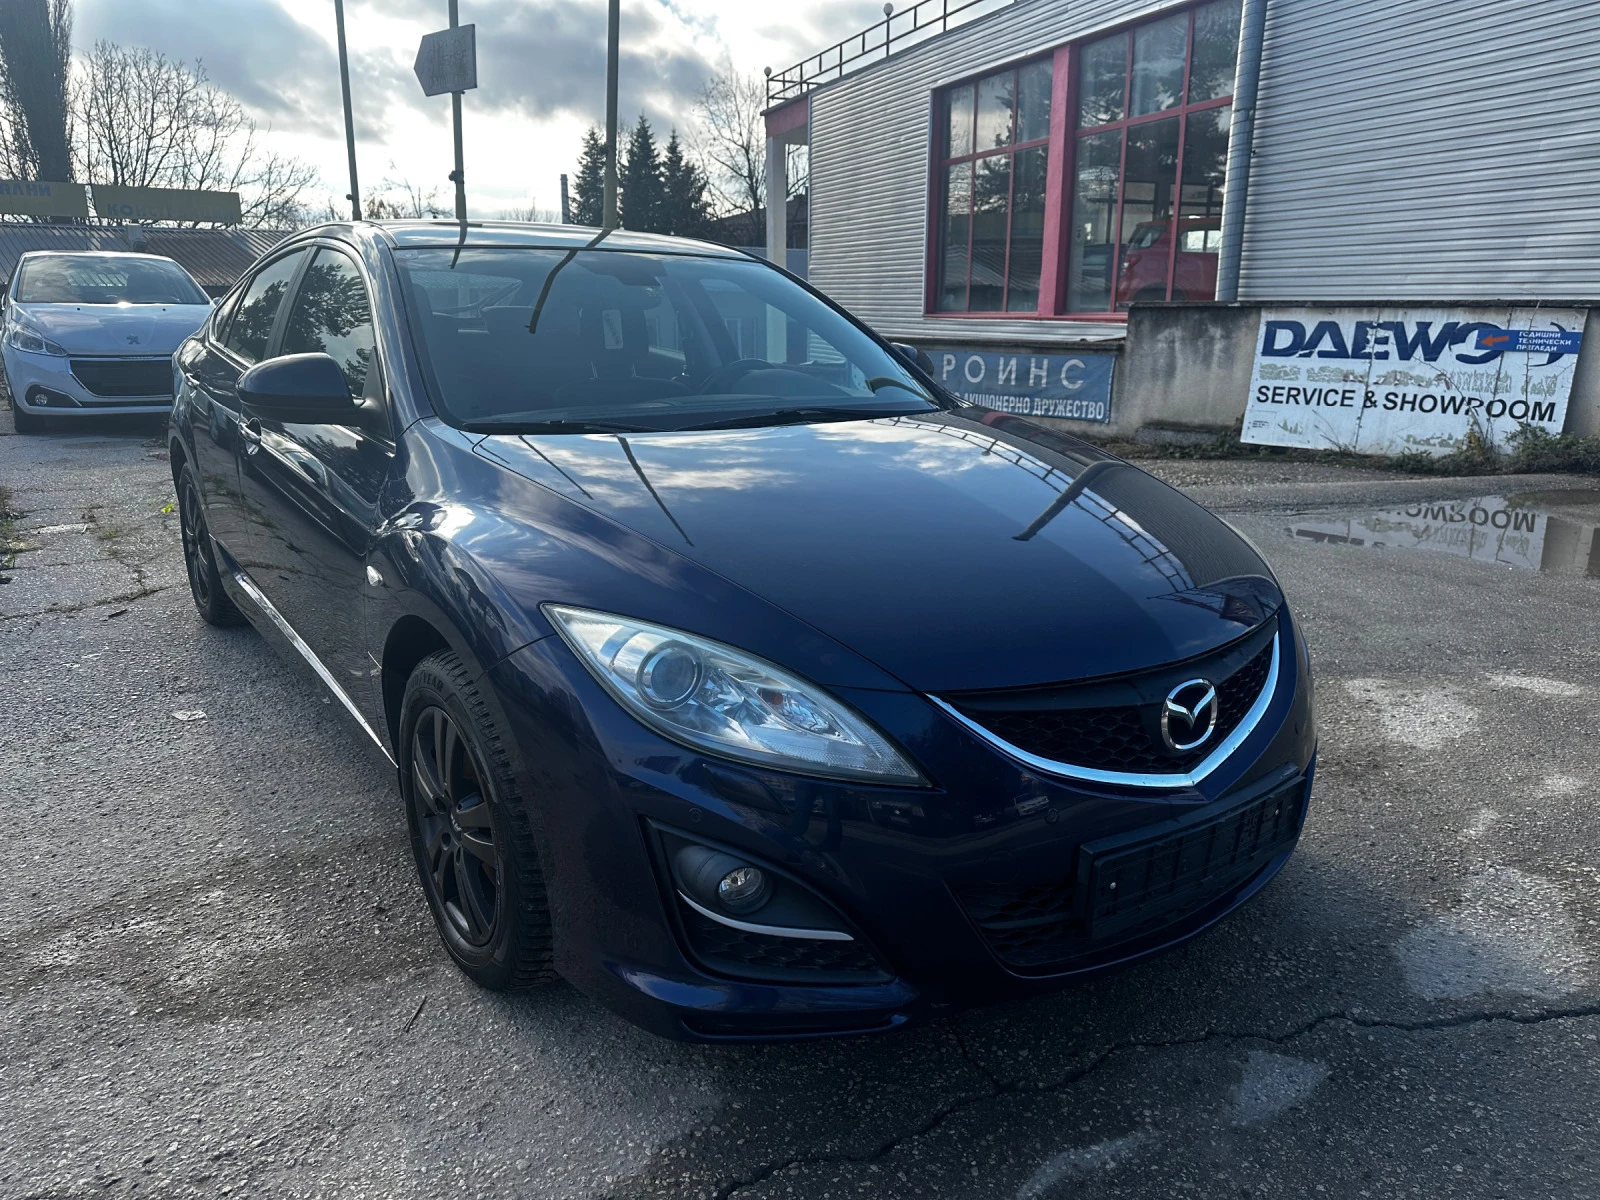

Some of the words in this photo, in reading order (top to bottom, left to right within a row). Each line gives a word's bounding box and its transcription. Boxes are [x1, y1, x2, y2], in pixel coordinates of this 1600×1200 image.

[1032, 397, 1104, 419] ДРУЖЕСТВО
[1256, 385, 1356, 407] SERVICE
[1363, 390, 1378, 409] &
